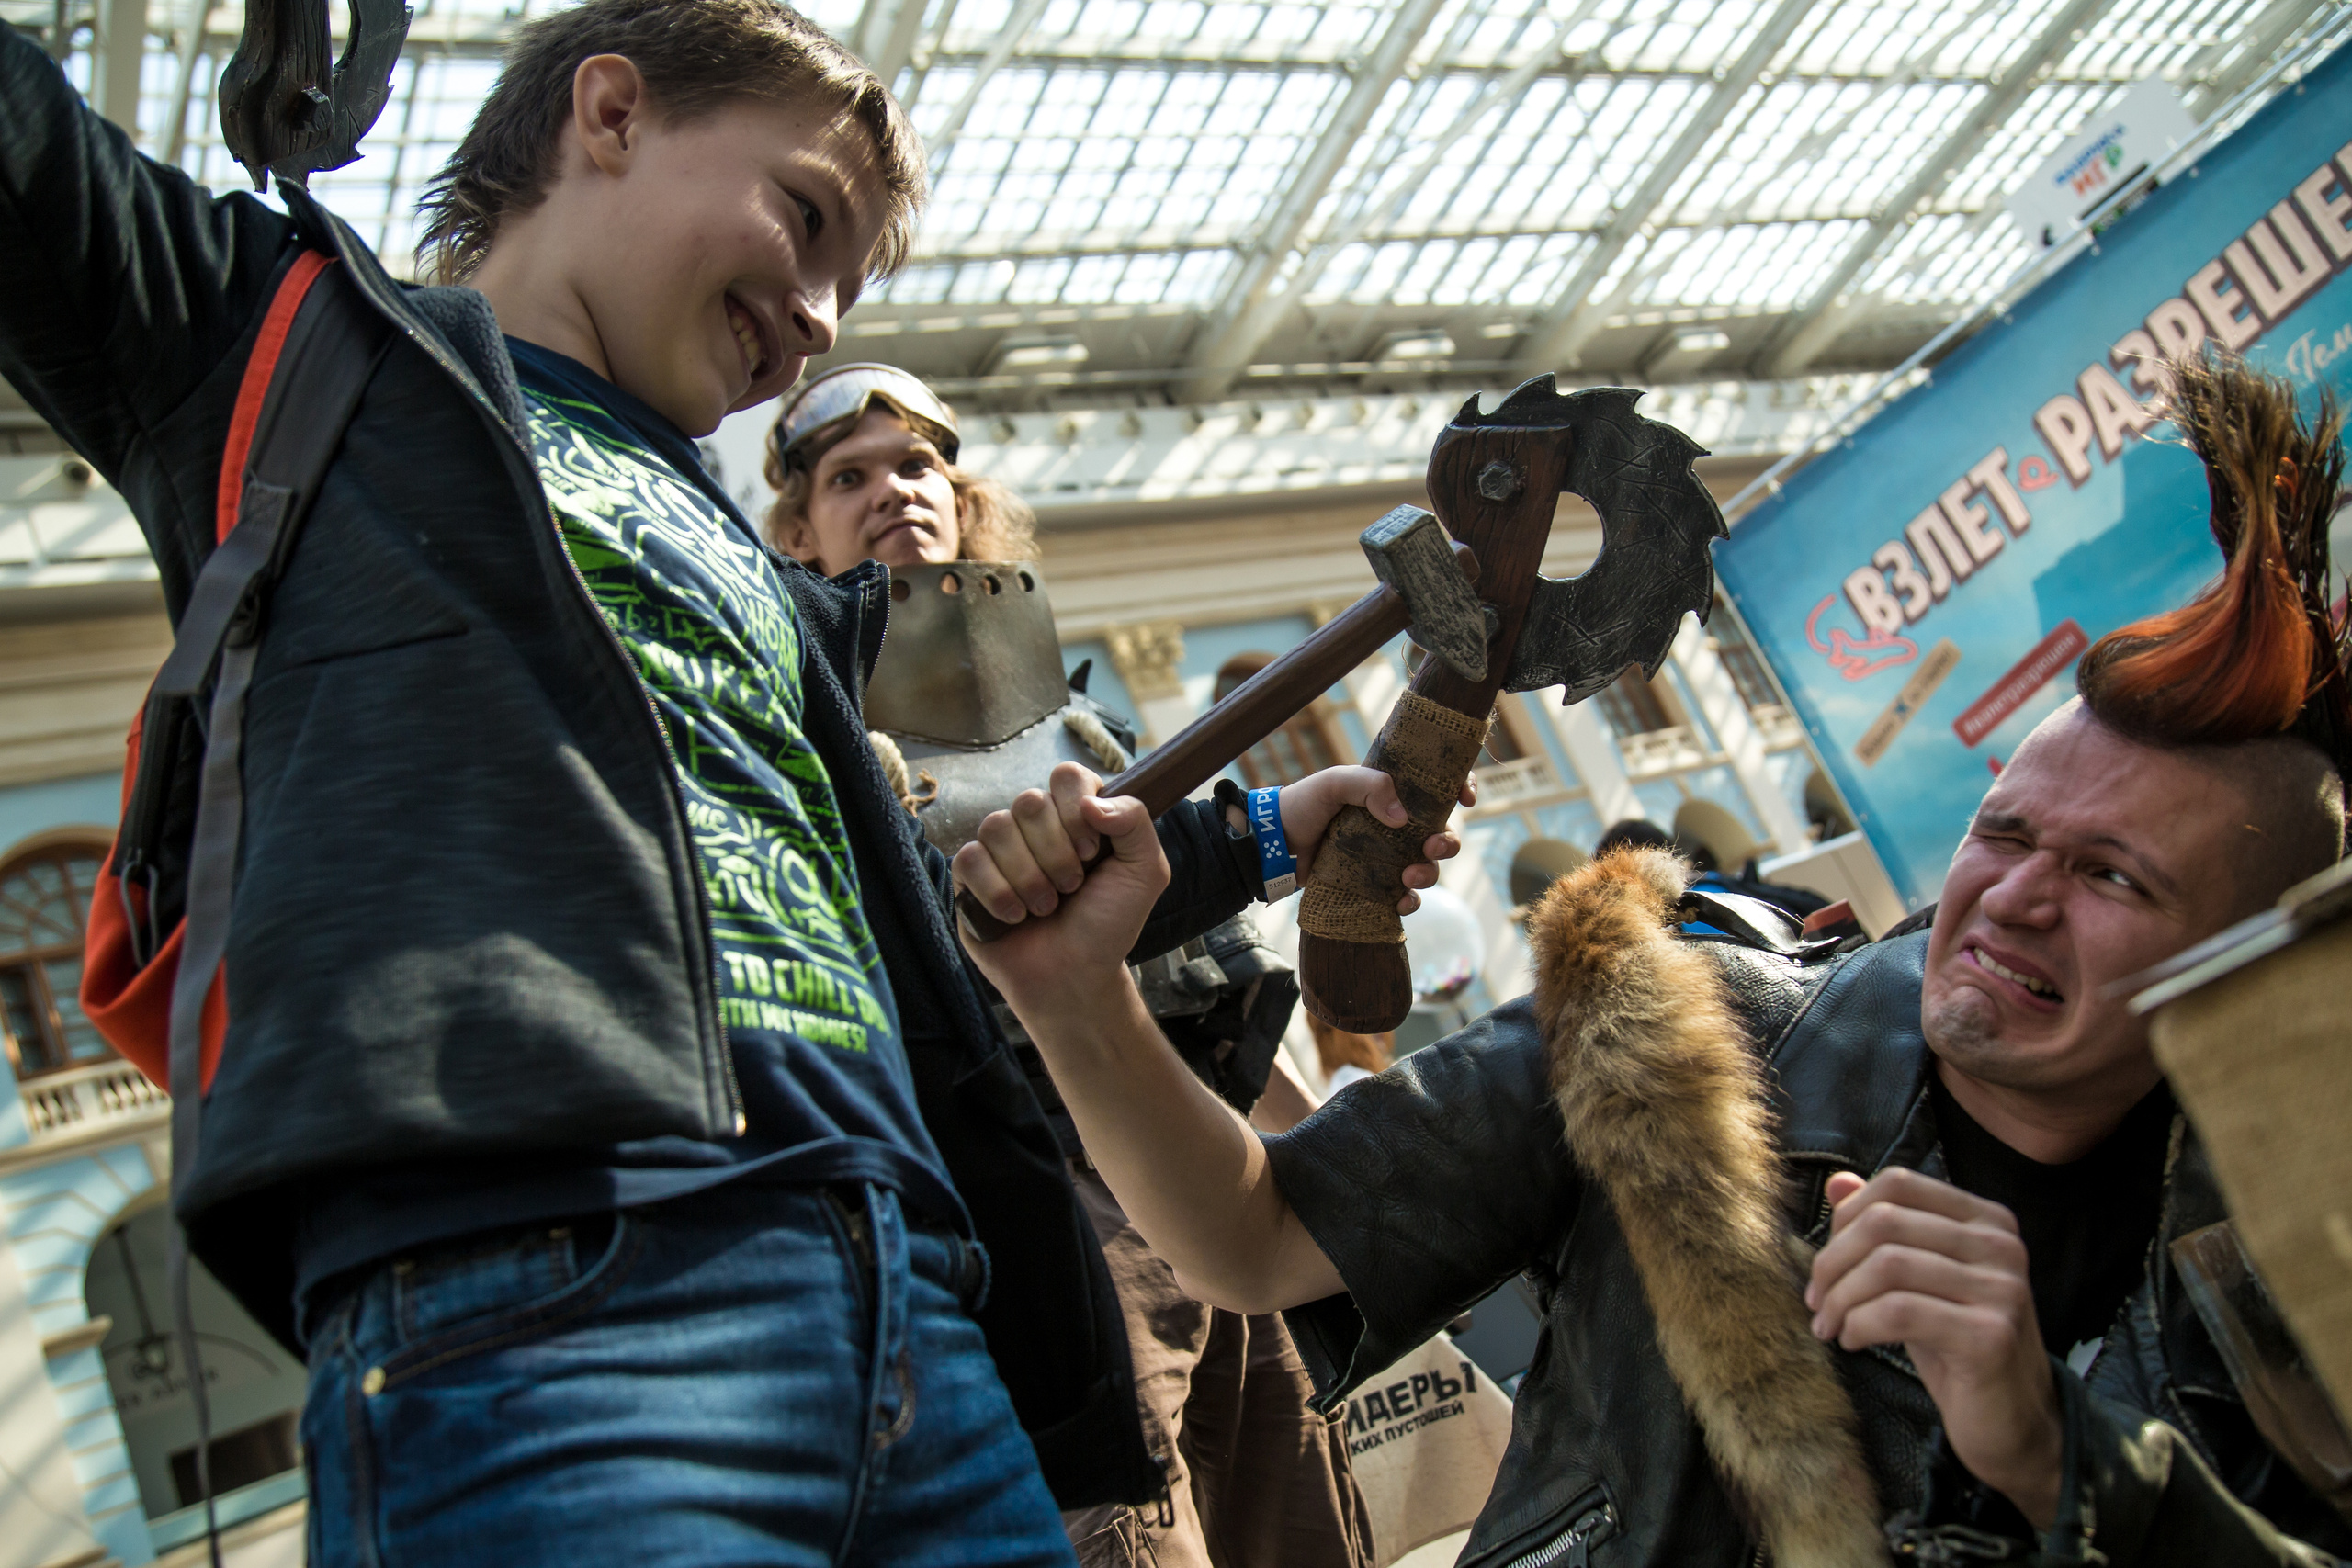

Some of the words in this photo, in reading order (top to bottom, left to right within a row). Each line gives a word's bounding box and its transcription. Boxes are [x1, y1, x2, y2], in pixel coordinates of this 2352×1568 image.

[1842, 446, 2032, 637] ВЗЛЕТ
[1269, 876, 1292, 890] 512937
[772, 959, 856, 1017] CHILL
[1384, 1399, 1465, 1442] ПУСТОШЕЙ
